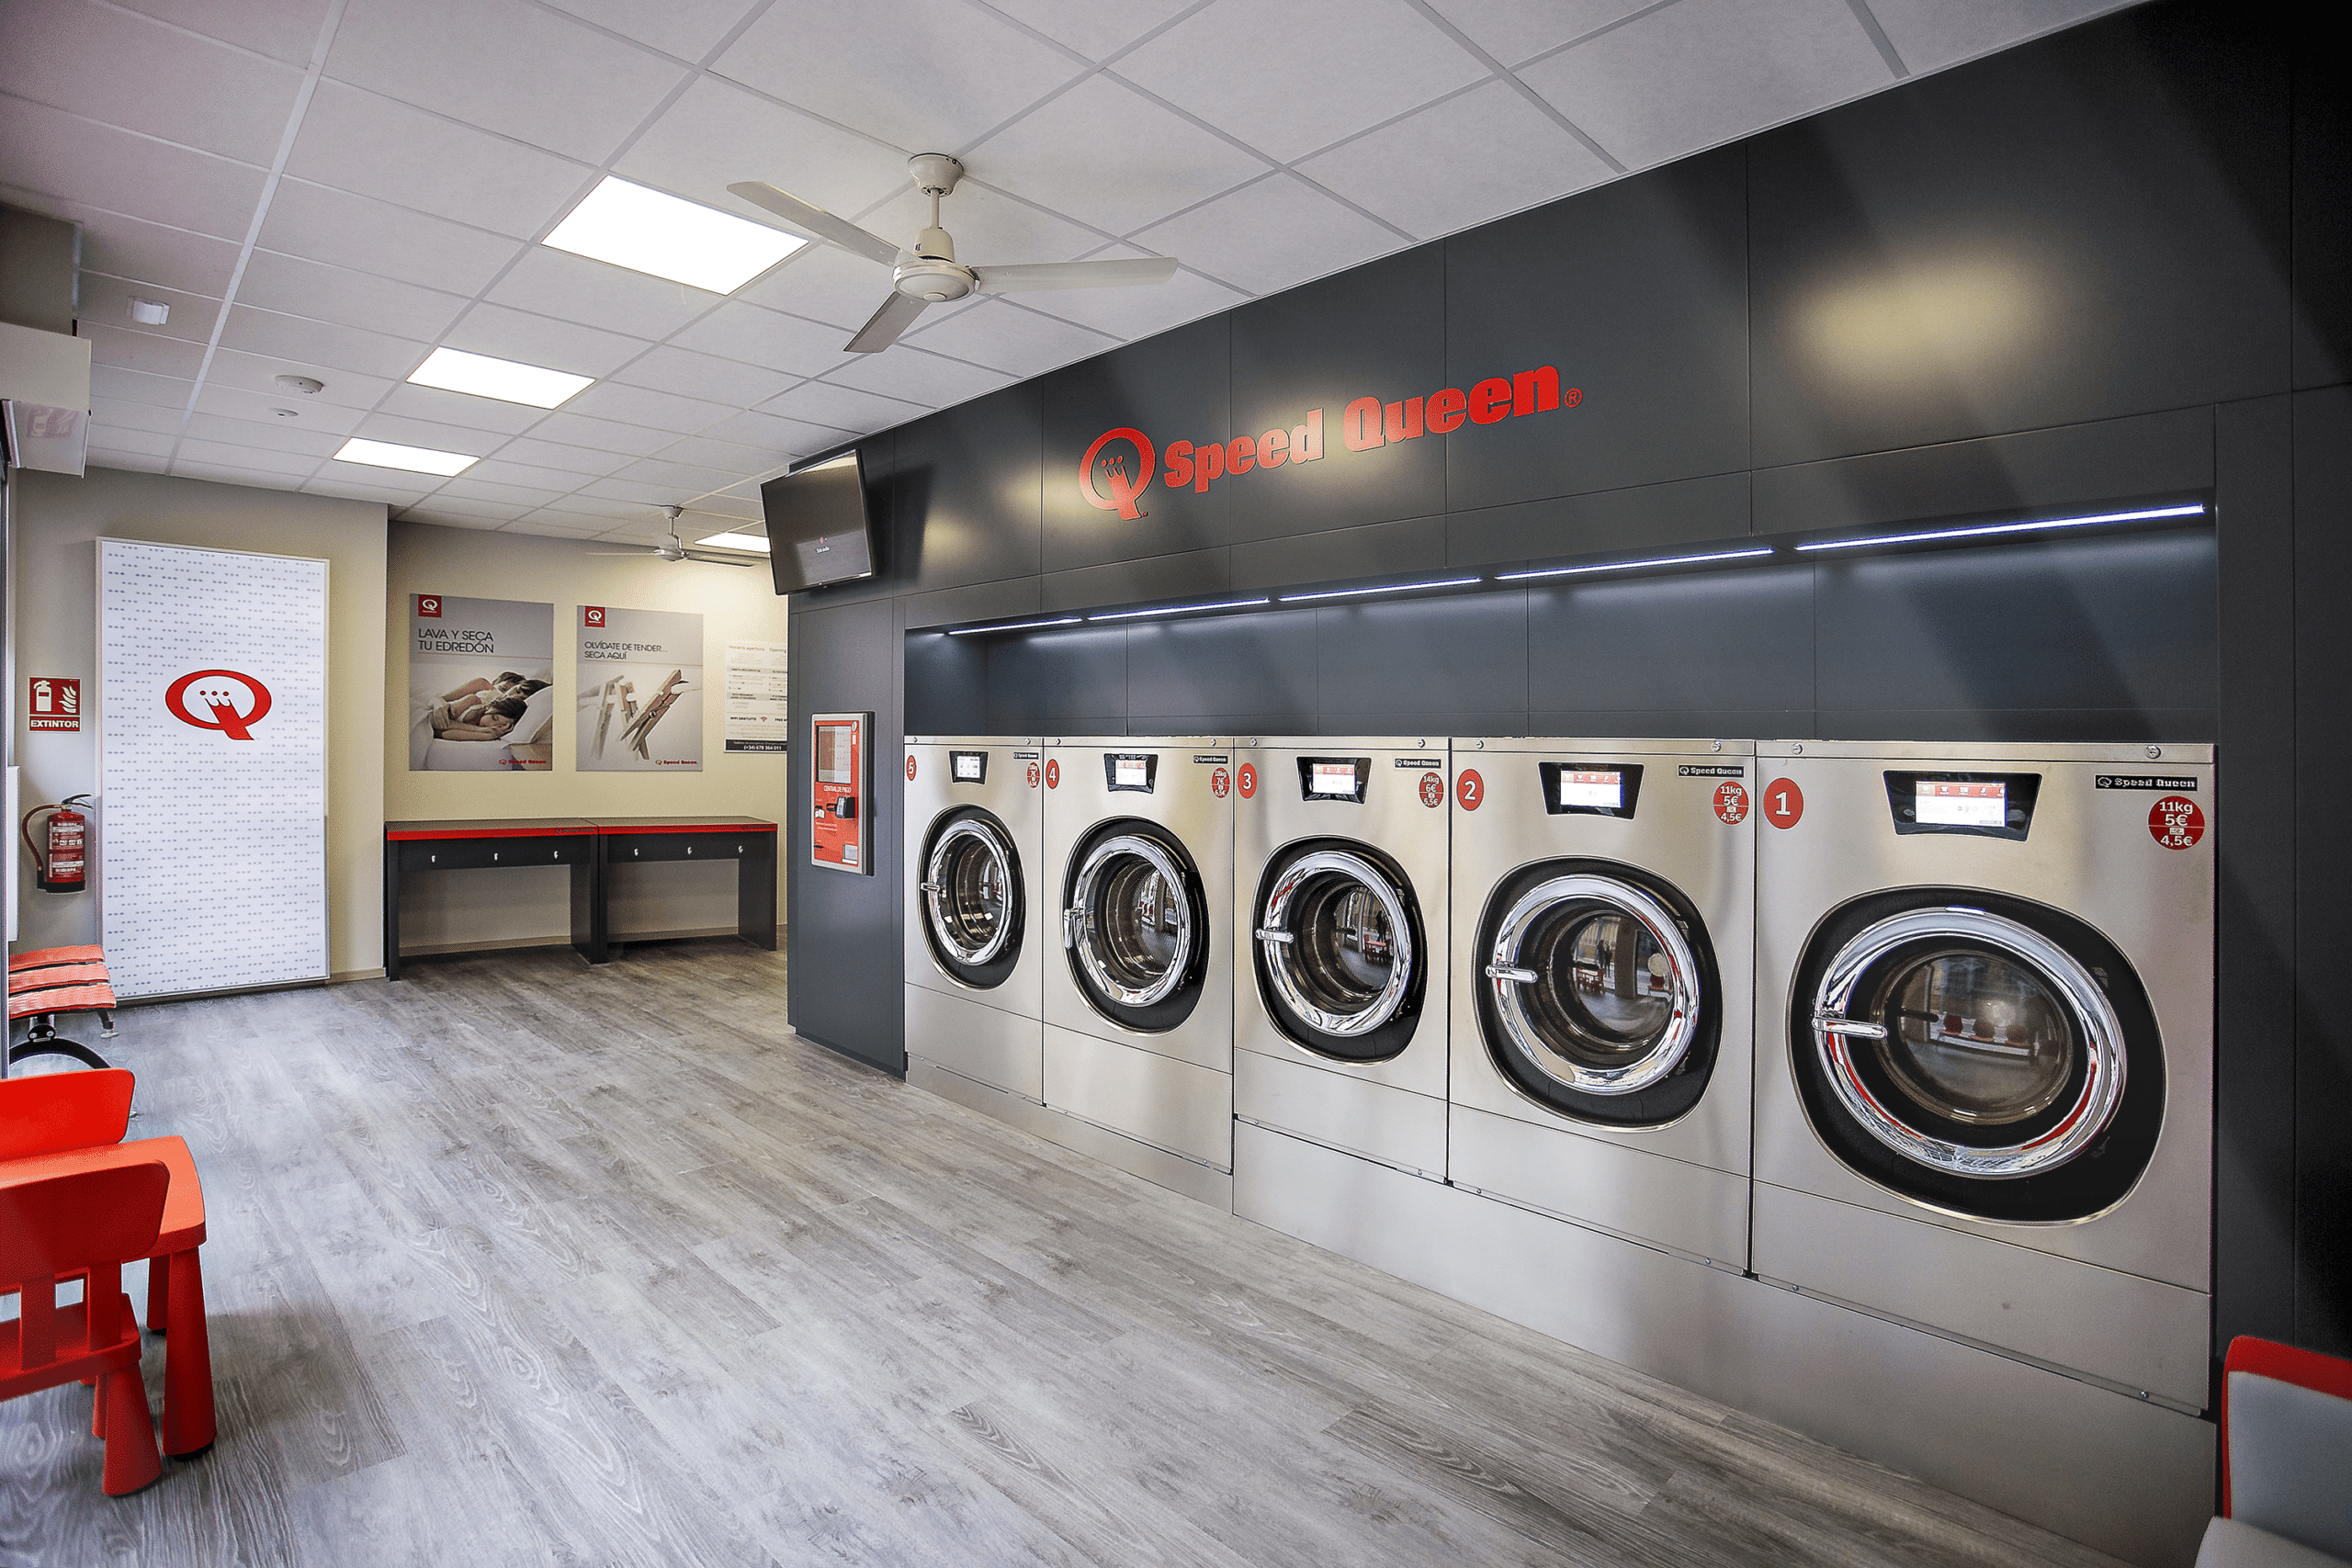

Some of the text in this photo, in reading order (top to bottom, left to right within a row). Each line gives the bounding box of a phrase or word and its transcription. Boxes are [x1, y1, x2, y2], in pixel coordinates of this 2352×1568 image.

[1163, 407, 1325, 494] Speed
[1342, 365, 1560, 453] Queen
[418, 628, 494, 641] LAVA Y SECA
[418, 640, 494, 653] TU EDREDÓN
[584, 640, 620, 650] OLVÍDATE
[622, 643, 633, 651] DE
[584, 650, 627, 660] SECA AQUÍ
[30, 719, 79, 728] EXTINTOR
[909, 761, 914, 774] 5
[1690, 767, 1715, 775] Speed
[1048, 767, 1057, 782] 4
[1423, 775, 1440, 785] 14kg
[1242, 773, 1253, 790] 3
[2114, 777, 2153, 788] Speed
[2155, 778, 2196, 788] Queen
[1425, 784, 1437, 793] 6€
[1464, 779, 1476, 801] 2
[1720, 785, 1743, 796] 11kg
[1423, 797, 1439, 807] 5,5€
[1724, 795, 1739, 806] 5€
[1774, 791, 1792, 817] 1
[2159, 801, 2194, 815] 11kg
[1720, 812, 1742, 823] 4,5€
[2165, 813, 2188, 827] 5€
[2160, 835, 2193, 847] 4,5€
